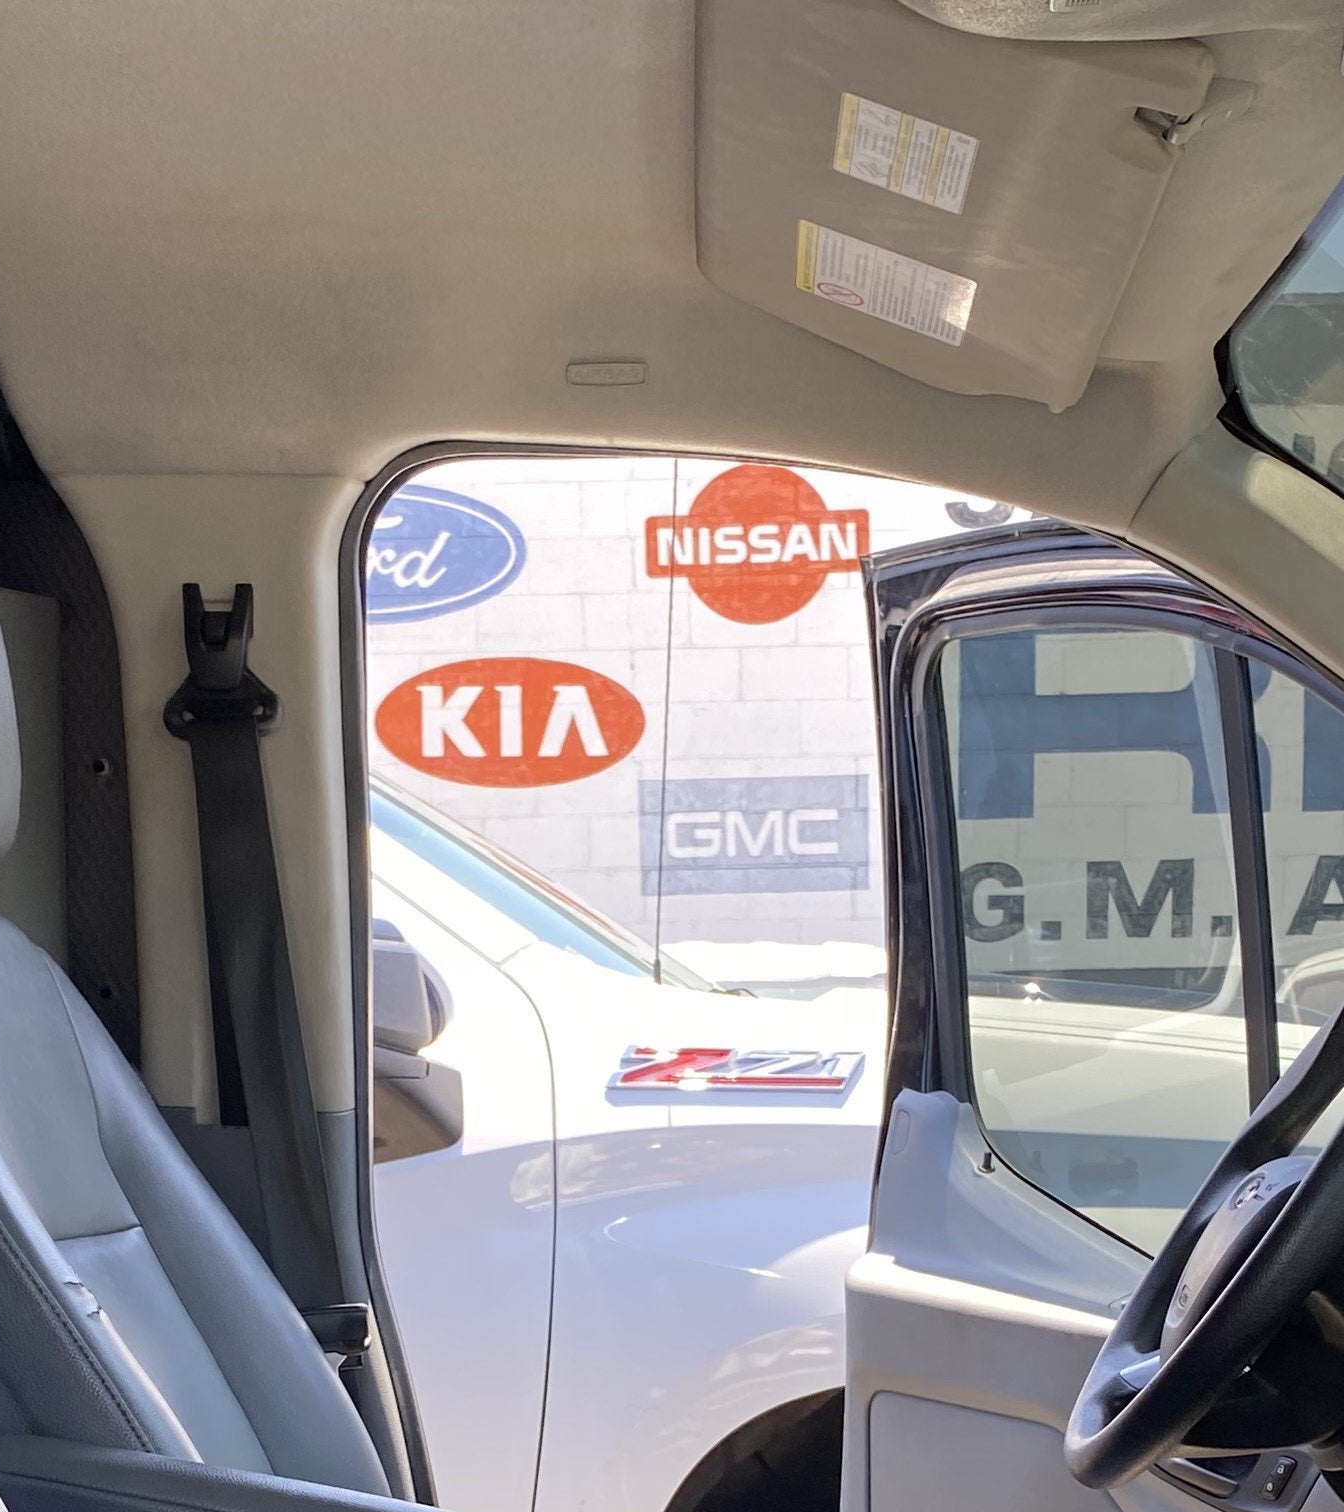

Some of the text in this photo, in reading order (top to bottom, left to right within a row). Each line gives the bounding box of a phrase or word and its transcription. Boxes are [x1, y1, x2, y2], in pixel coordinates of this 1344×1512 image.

[656, 522, 856, 566] NISSAN
[416, 684, 609, 758] KIA
[666, 808, 840, 859] GMC
[961, 856, 1233, 945] G.M.
